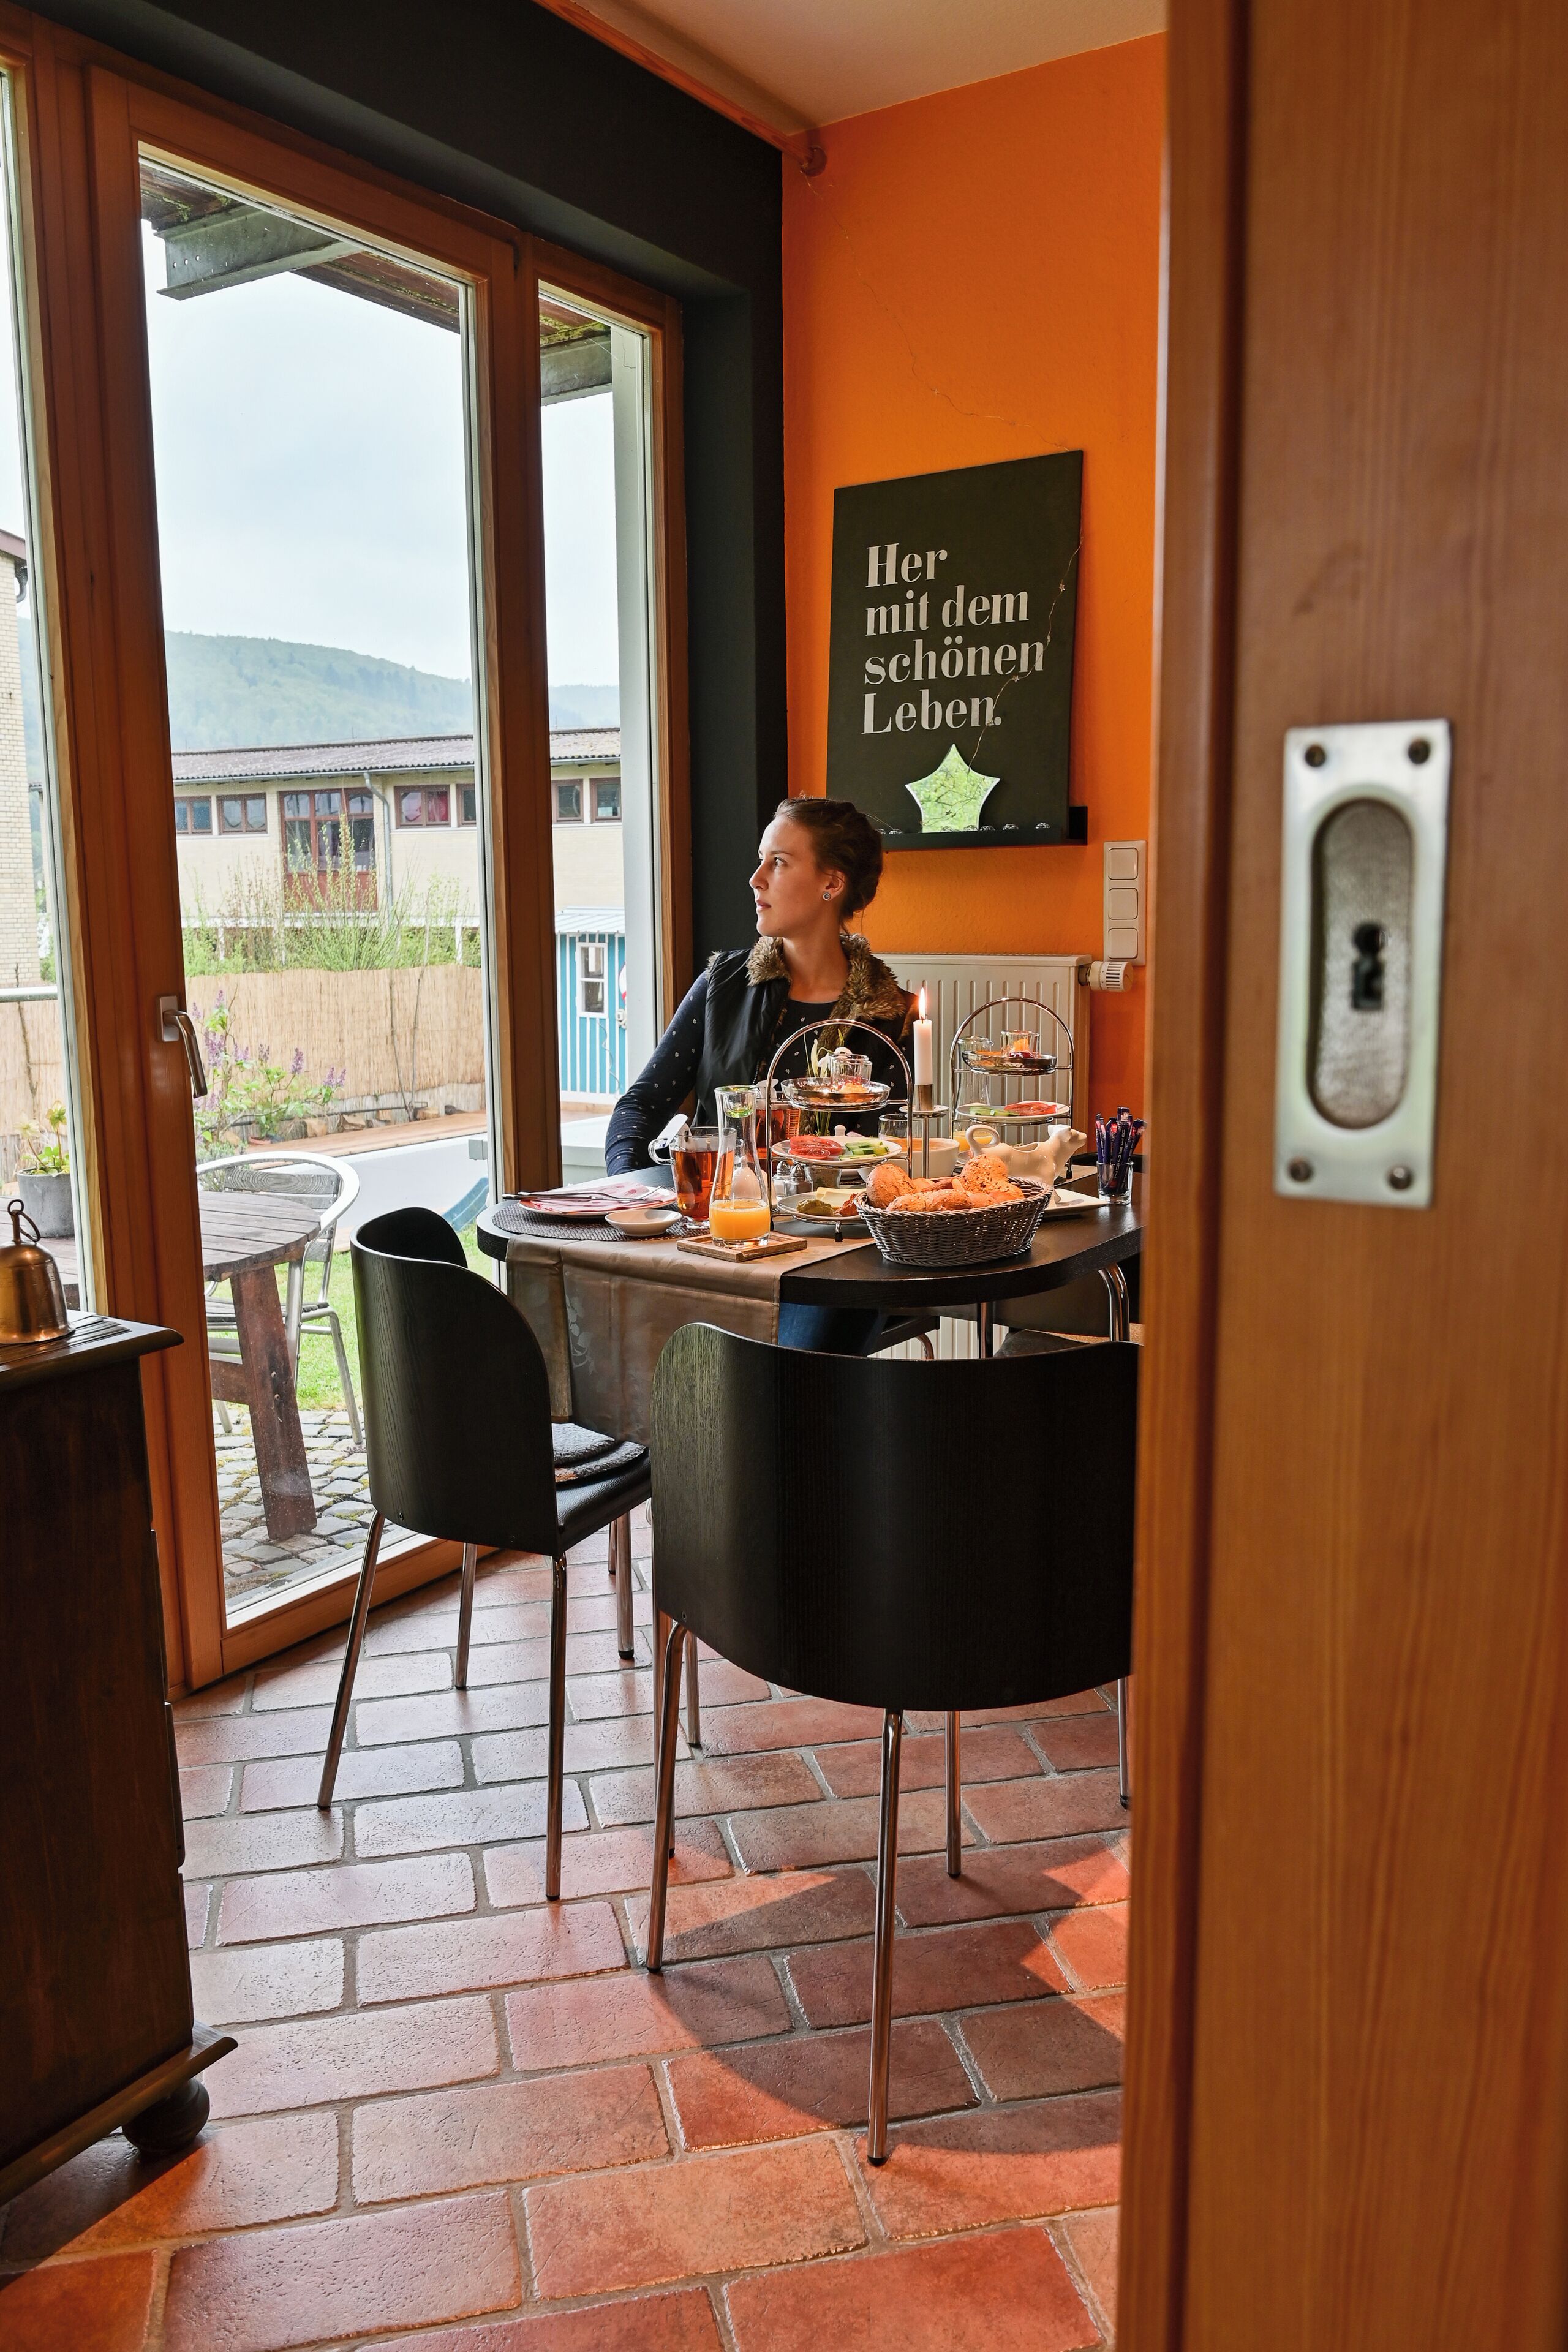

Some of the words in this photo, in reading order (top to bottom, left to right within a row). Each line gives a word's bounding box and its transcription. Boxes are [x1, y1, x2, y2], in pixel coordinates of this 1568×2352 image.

[865, 543, 948, 588] Her
[865, 590, 930, 636] mit
[941, 584, 1029, 627] dem
[864, 635, 1044, 685] schönen
[861, 689, 1002, 734] Leben.
[1114, 1129, 1125, 1178] ZUCKER
